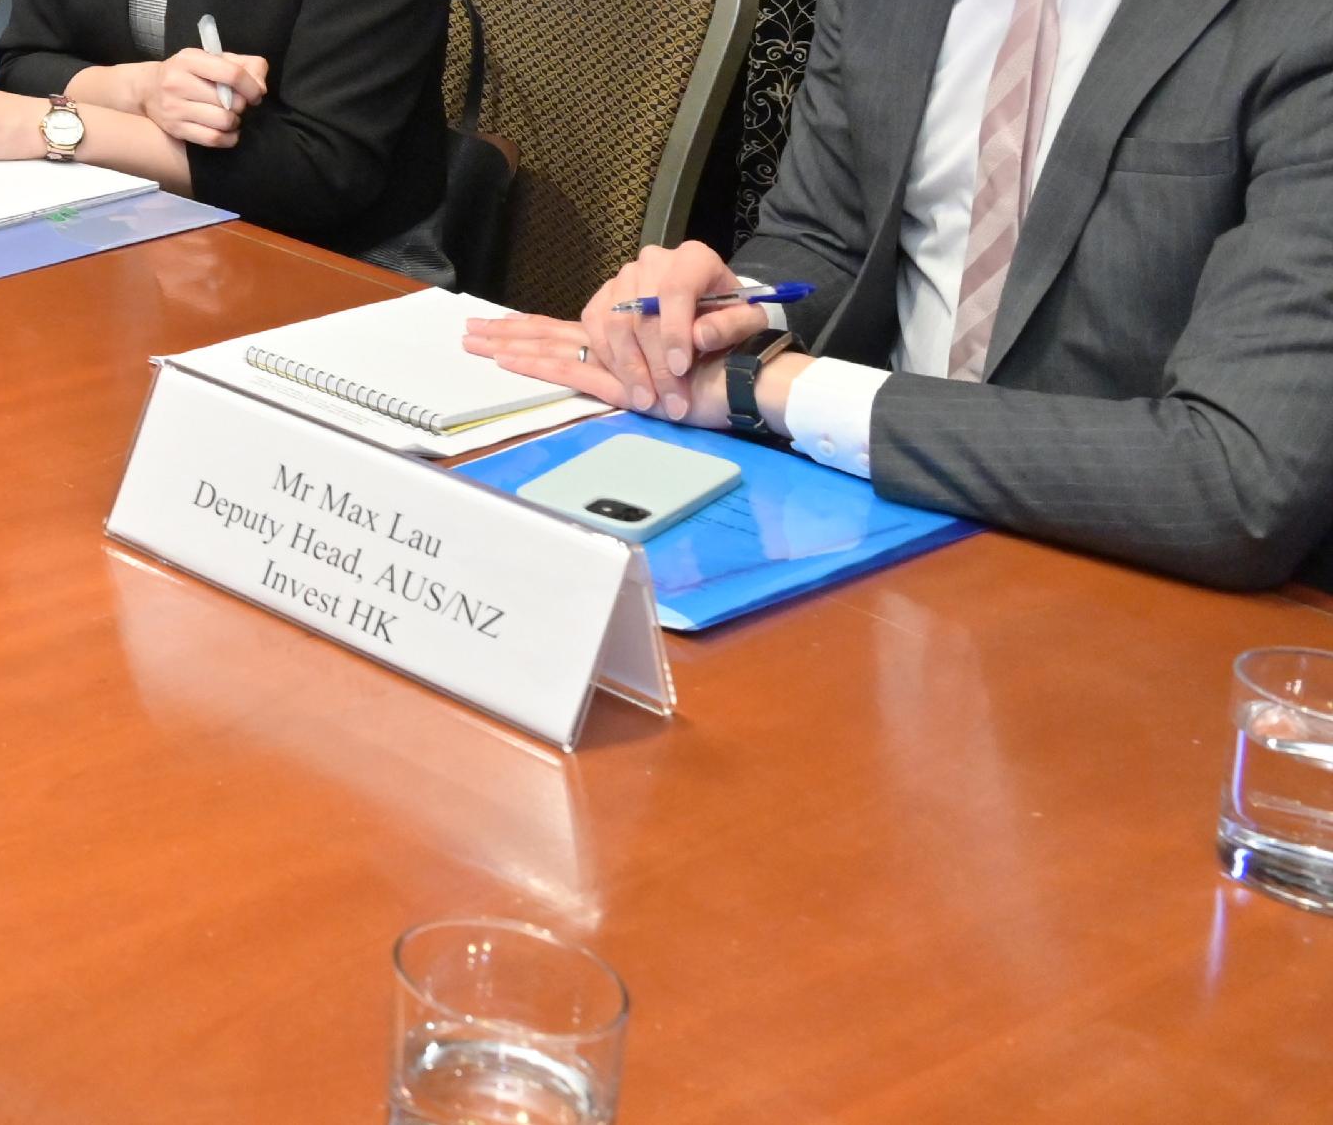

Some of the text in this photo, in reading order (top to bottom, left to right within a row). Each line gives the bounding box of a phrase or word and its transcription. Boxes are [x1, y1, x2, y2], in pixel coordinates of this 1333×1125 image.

[272, 463, 443, 559] Mr Max Lau
[192, 479, 507, 640] Deputy Head, AUS/NZ
[259, 559, 402, 645] Invest HK
